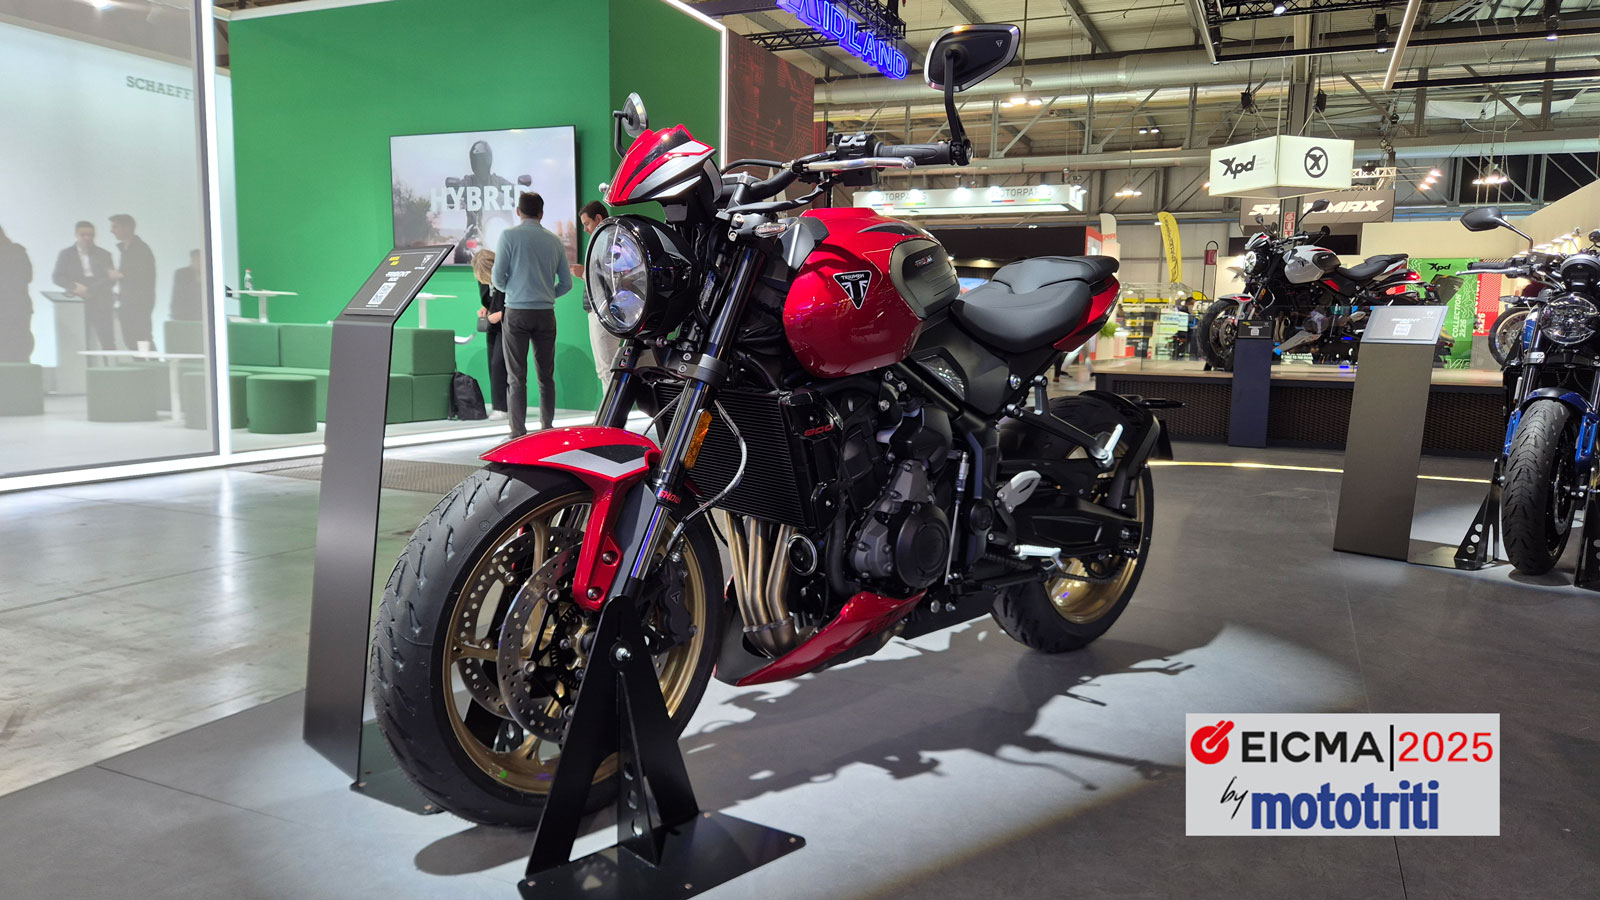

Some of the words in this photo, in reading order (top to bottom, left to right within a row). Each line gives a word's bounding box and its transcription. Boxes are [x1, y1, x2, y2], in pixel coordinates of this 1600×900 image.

[1219, 155, 1256, 179] Xpd
[1427, 263, 1451, 272] Xpd
[1452, 293, 1462, 338] COLLECTION
[804, 423, 834, 437] 800
